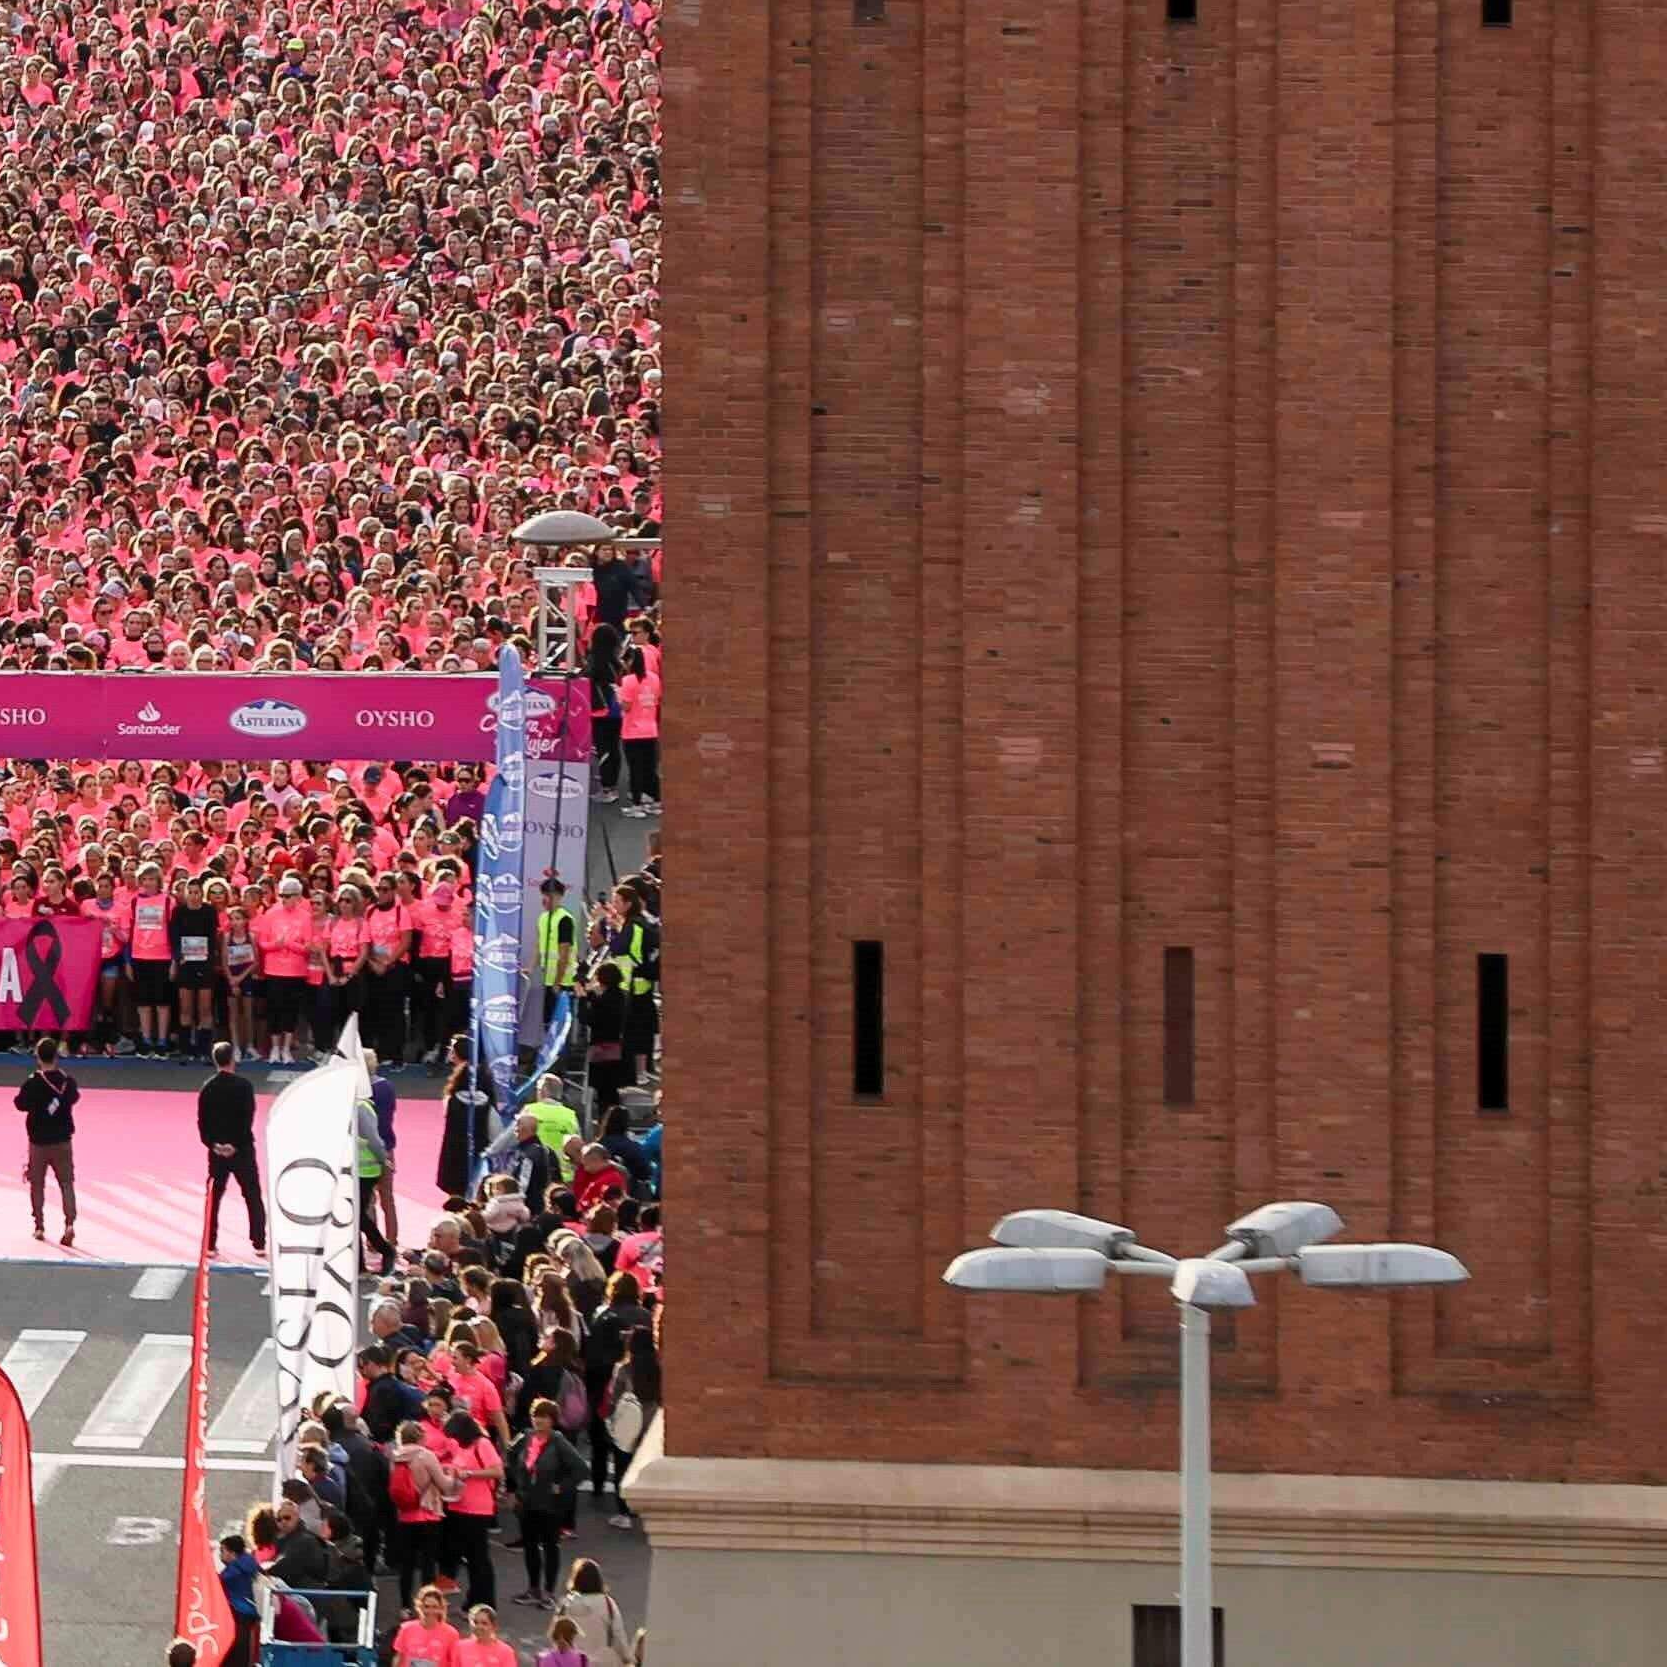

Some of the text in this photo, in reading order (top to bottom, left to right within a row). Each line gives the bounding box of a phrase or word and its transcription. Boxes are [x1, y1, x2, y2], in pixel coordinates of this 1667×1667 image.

[235, 712, 302, 727] ASTURIANA
[355, 710, 435, 727] OYSHO
[117, 722, 181, 735] Santander
